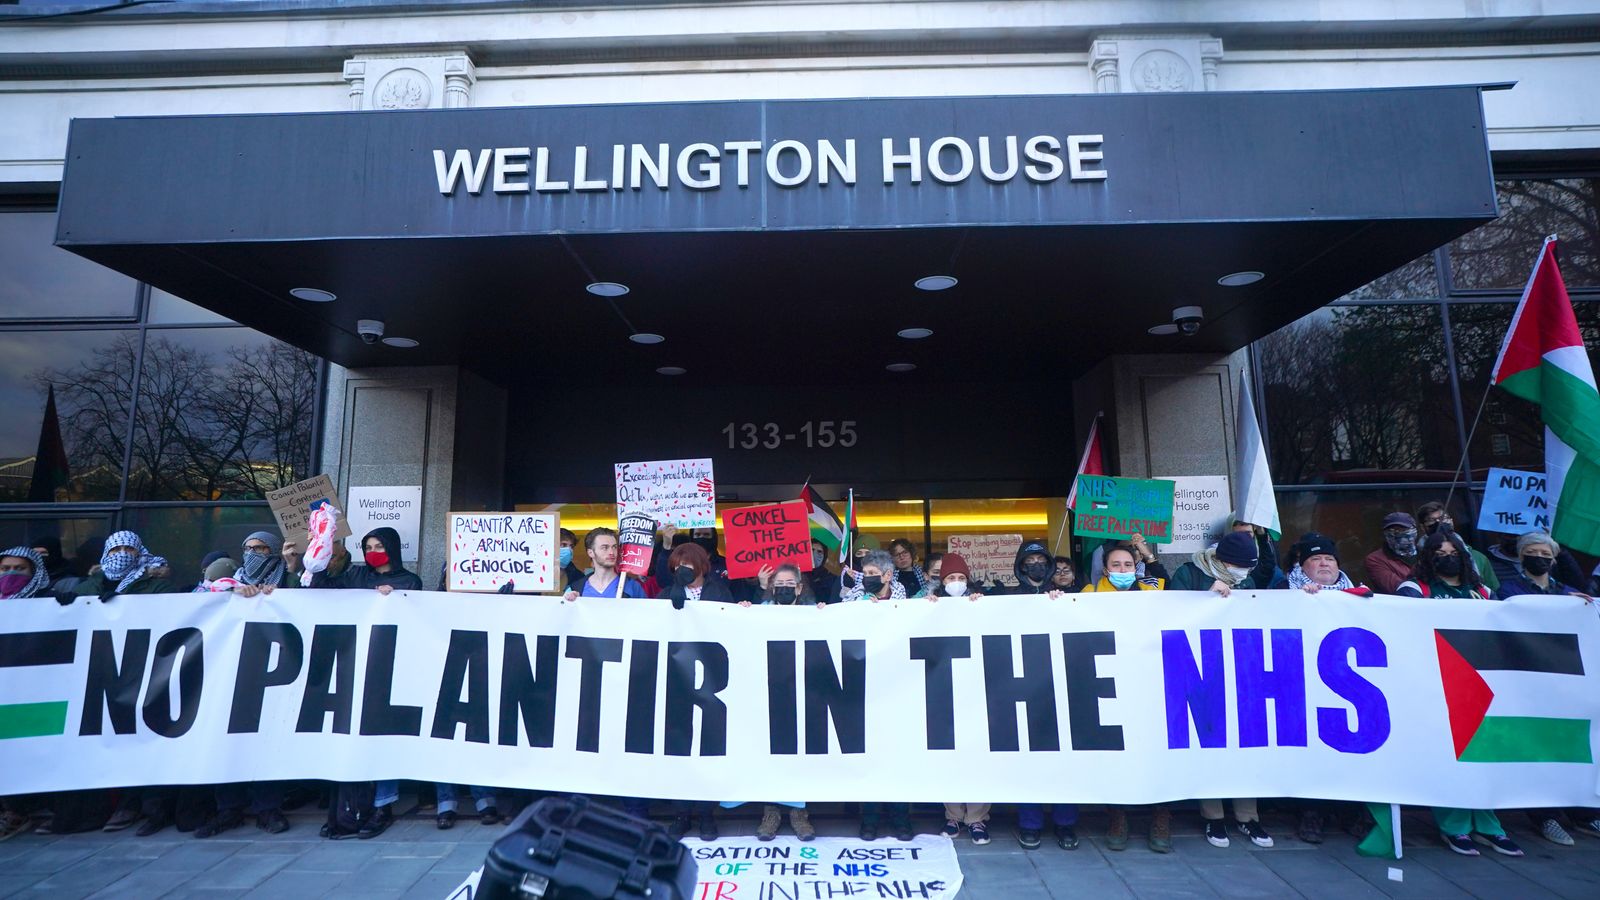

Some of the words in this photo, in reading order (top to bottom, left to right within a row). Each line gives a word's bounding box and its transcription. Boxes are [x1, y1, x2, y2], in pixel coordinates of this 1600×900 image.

[433, 139, 857, 195] WELLINGTON
[881, 134, 1108, 183] HOUSE
[722, 421, 857, 449] 133-155
[1080, 479, 1118, 499] NHS
[1500, 475, 1522, 490] NO
[271, 487, 297, 501] Cancel
[297, 479, 325, 493] Palantir
[1174, 489, 1218, 500] ellington
[290, 490, 324, 507] Contract
[359, 499, 411, 510] Wellington
[1528, 496, 1547, 509] IN
[1176, 502, 1210, 511] House
[280, 512, 297, 521] Free
[368, 511, 400, 520] House
[731, 508, 800, 527] CANCEL
[1494, 512, 1527, 525] THE
[285, 522, 302, 531] Free
[518, 517, 544, 533] ARE
[621, 517, 654, 531] FREEDOM
[1076, 513, 1107, 532] FREE
[1107, 516, 1169, 537] PALESTINE
[1178, 523, 1210, 531] 133-155
[751, 527, 785, 543] THE
[1173, 533, 1201, 541] aterloo
[951, 537, 971, 549] Stop
[734, 540, 811, 564] CONTRACT
[79, 626, 204, 738] NO
[227, 621, 729, 757] PALANTIR
[766, 639, 866, 755] IN
[909, 630, 1125, 752] THE
[1161, 626, 1391, 754] NHS
[689, 847, 790, 859] SATION
[800, 847, 819, 859] &
[837, 848, 922, 860] ASSET
[715, 863, 752, 876] OF
[765, 863, 818, 876] THE
[833, 863, 890, 877] NHS
[759, 881, 798, 900] IN
